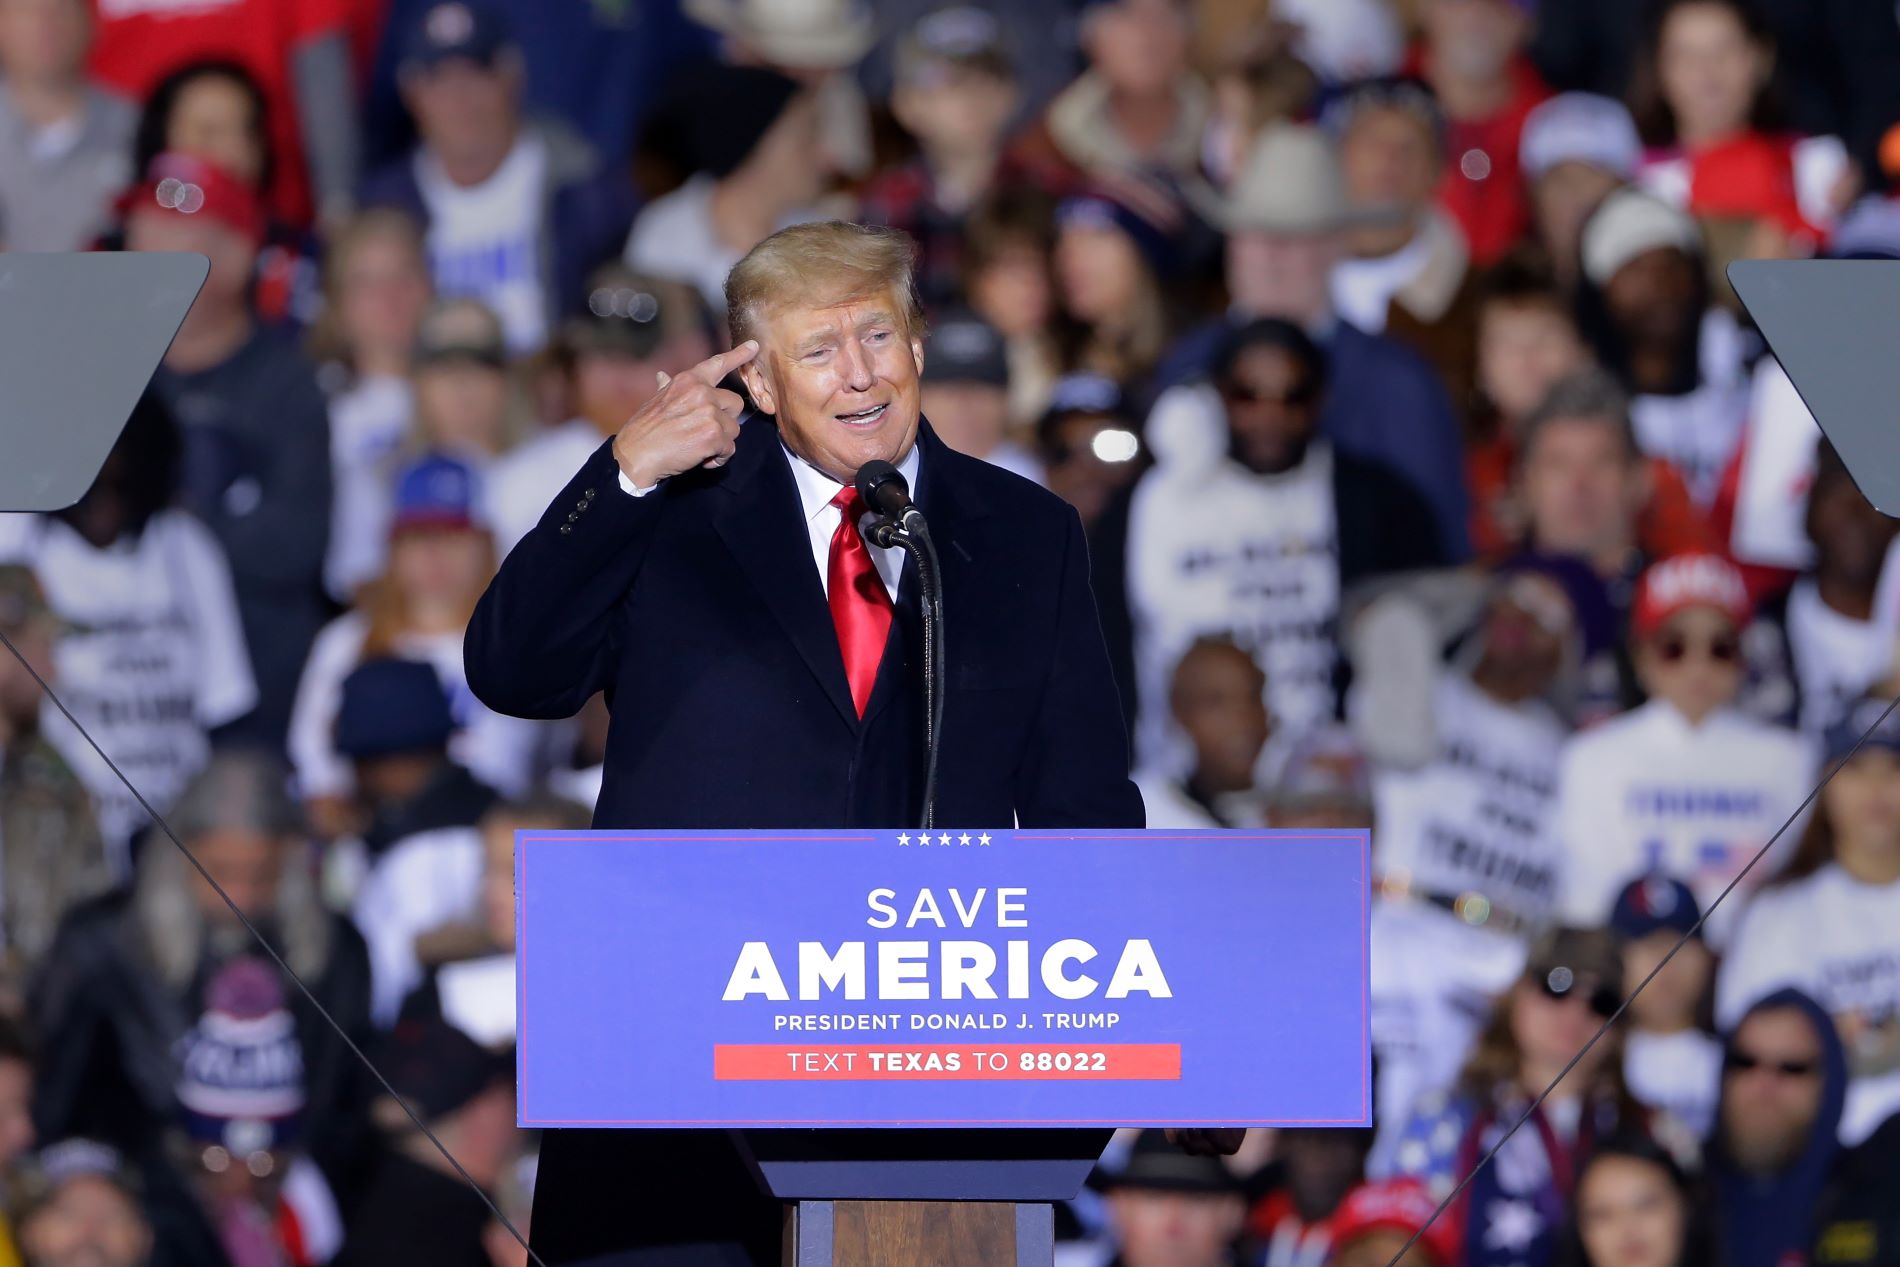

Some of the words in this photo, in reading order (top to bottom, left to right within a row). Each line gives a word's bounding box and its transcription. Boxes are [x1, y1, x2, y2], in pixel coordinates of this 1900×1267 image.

[866, 887, 1028, 929] SAVE
[722, 938, 1173, 1001] AMERICA
[774, 1014, 902, 1031] PRESIDENT
[910, 1013, 1007, 1030] DONALD
[1016, 1013, 1034, 1029] J.
[1042, 1012, 1120, 1029] TRUMP
[787, 1052, 857, 1072] TEXT
[868, 1052, 961, 1072] TEXAS
[973, 1052, 1009, 1072] TO
[1019, 1052, 1106, 1072] 88022
